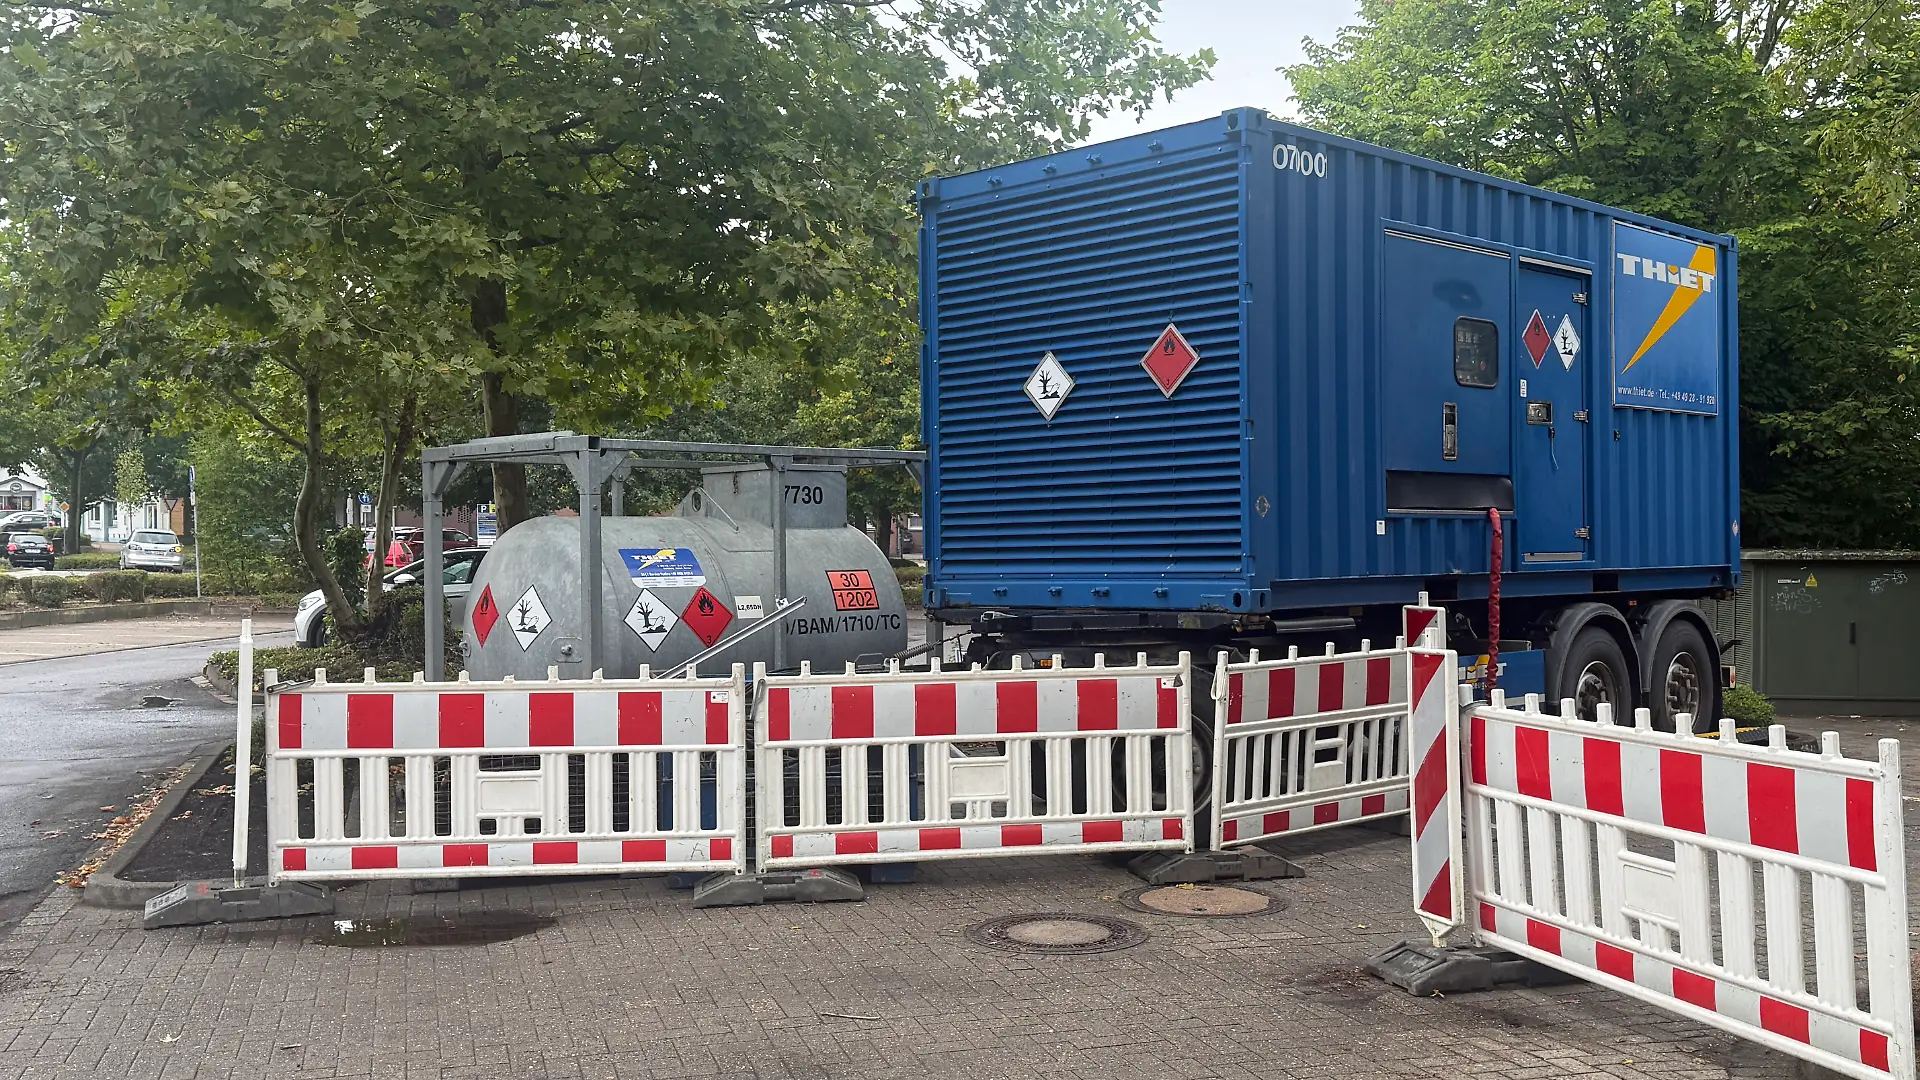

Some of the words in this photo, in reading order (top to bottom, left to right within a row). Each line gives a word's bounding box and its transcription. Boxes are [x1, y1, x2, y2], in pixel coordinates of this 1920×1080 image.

[840, 573, 860, 588] 30
[838, 591, 875, 608] 1202
[786, 613, 901, 636] /BAM/1710/TC
[706, 635, 712, 644] 3
